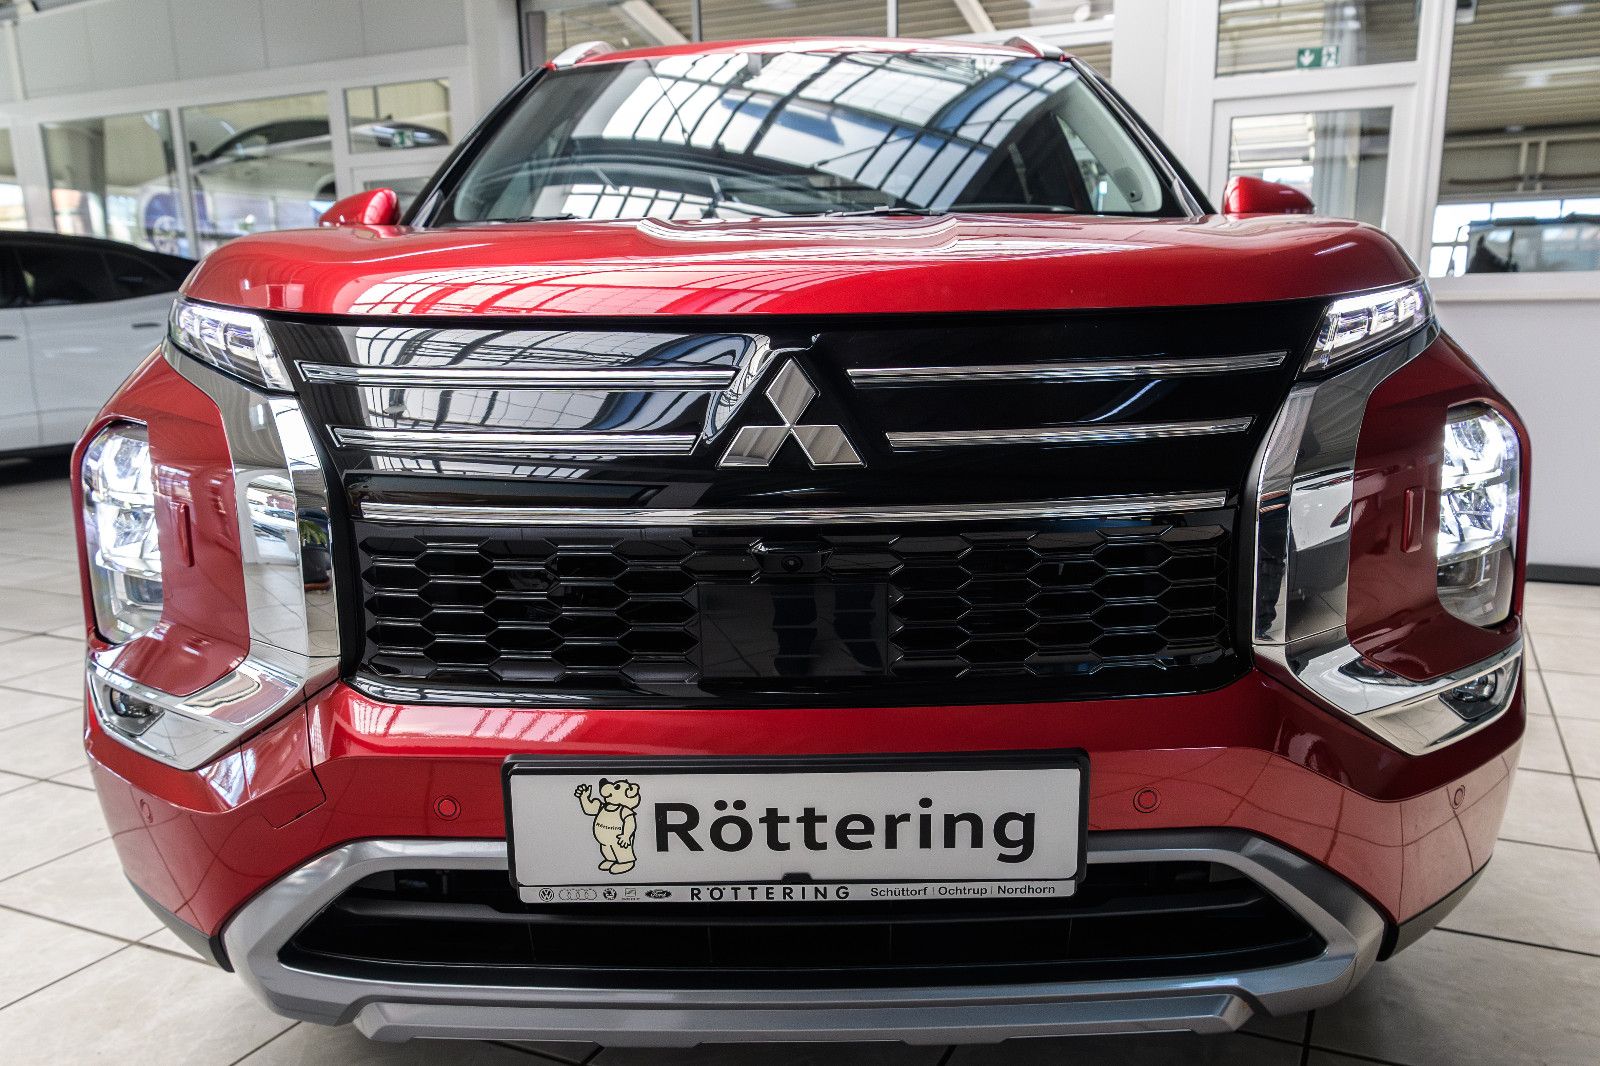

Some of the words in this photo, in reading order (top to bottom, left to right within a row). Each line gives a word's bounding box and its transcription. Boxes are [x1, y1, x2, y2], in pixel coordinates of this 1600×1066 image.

[654, 797, 1036, 864] Röttering
[690, 886, 850, 901] RÖTTERING
[870, 887, 928, 897] Schüttorf
[938, 886, 988, 896] Ochtrup
[997, 885, 1056, 895] Nordhorn
